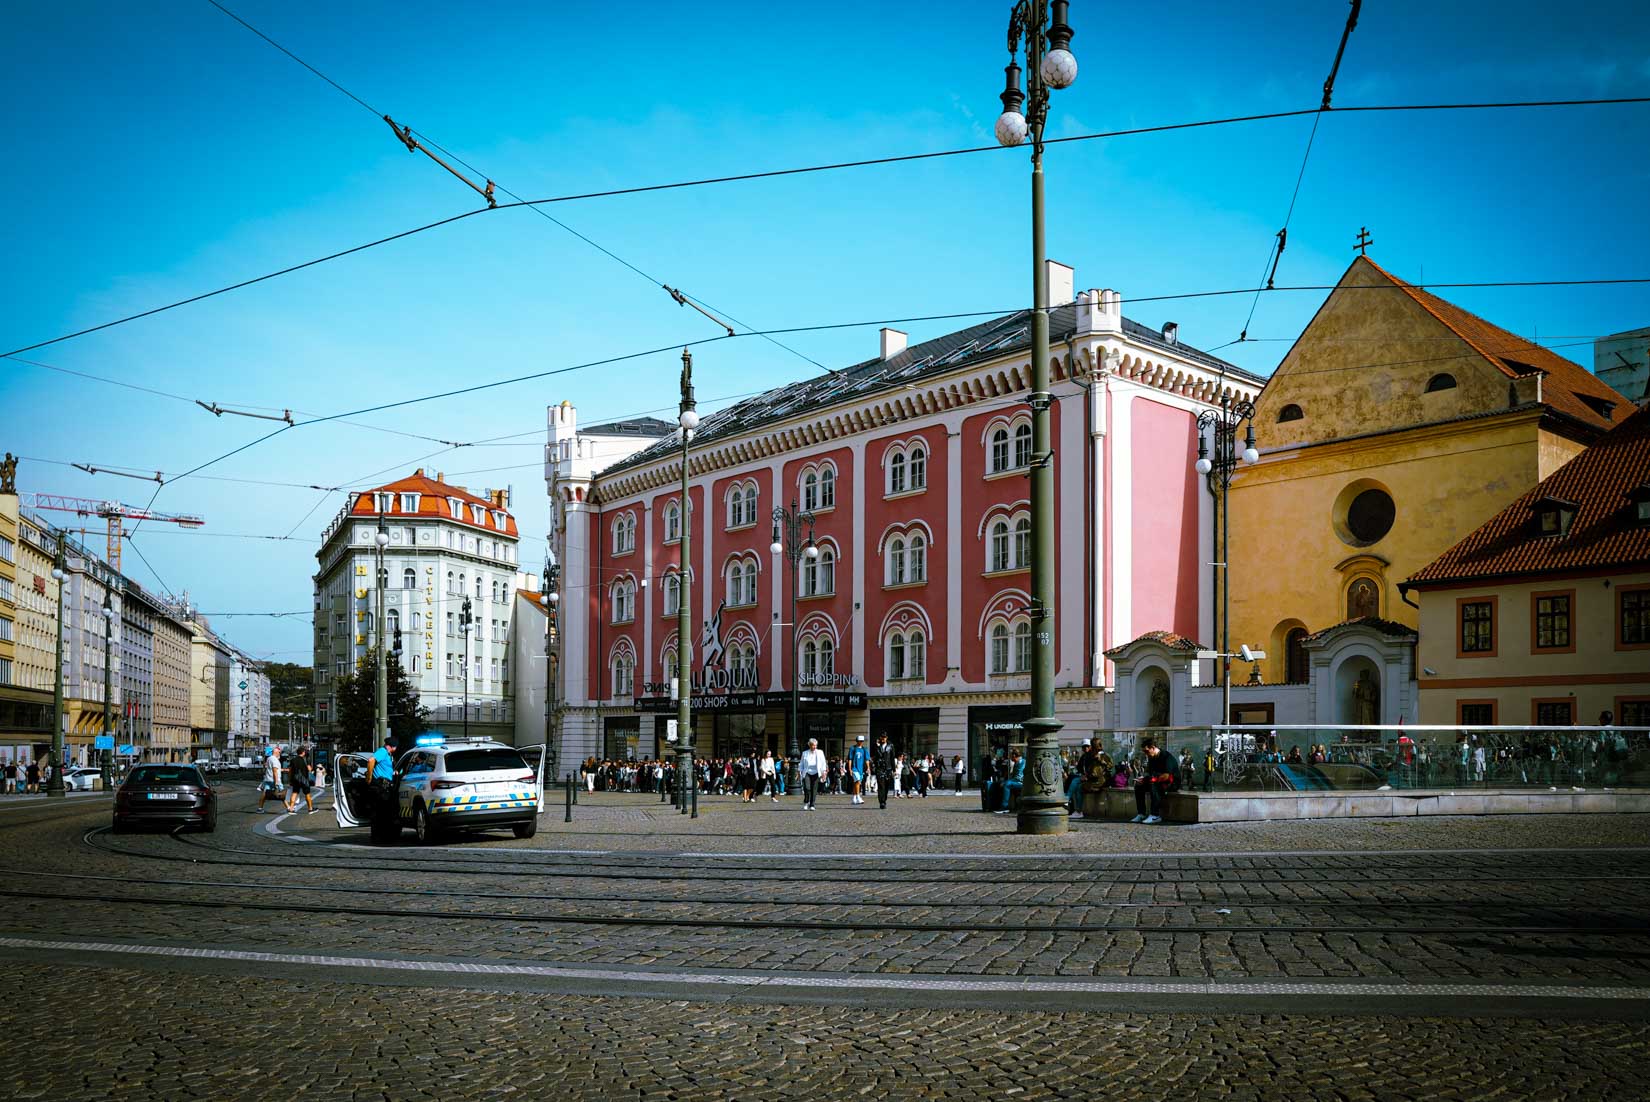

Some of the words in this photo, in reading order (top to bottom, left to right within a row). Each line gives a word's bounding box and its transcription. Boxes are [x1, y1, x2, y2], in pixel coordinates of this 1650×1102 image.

[425, 566, 433, 606] CITY
[425, 610, 433, 670] CENTRE
[798, 671, 861, 687] SHOPPING
[704, 696, 729, 709] SHOPS
